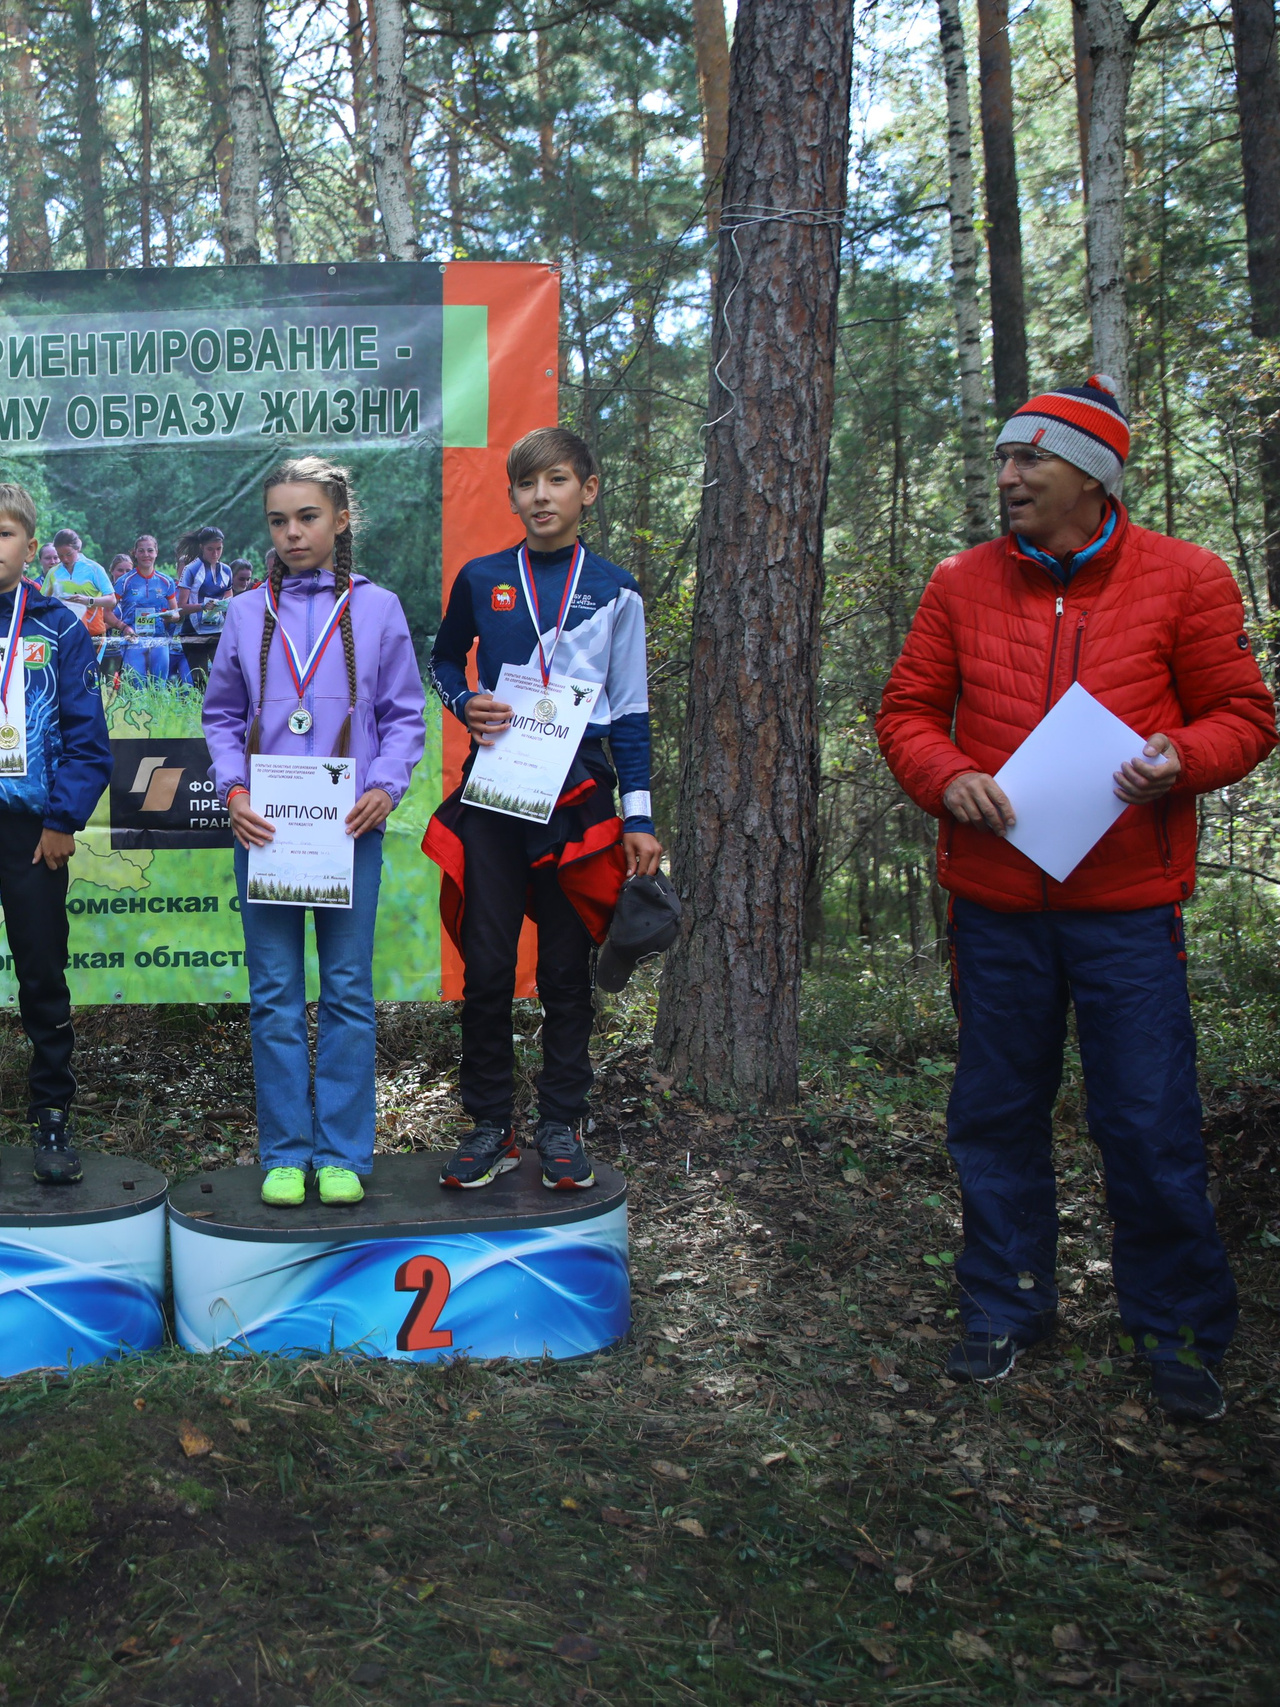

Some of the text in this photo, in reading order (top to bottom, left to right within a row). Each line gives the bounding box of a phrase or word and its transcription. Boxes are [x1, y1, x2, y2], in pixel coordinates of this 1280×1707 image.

[66, 390, 245, 441] ОБРАЗУ
[260, 387, 420, 435] ЖИЗНИ
[264, 804, 338, 820] ДИПЛОМ
[190, 818, 231, 828] ГРАН
[66, 896, 218, 914] юменская
[134, 945, 247, 969] област
[395, 1254, 453, 1351] 2
